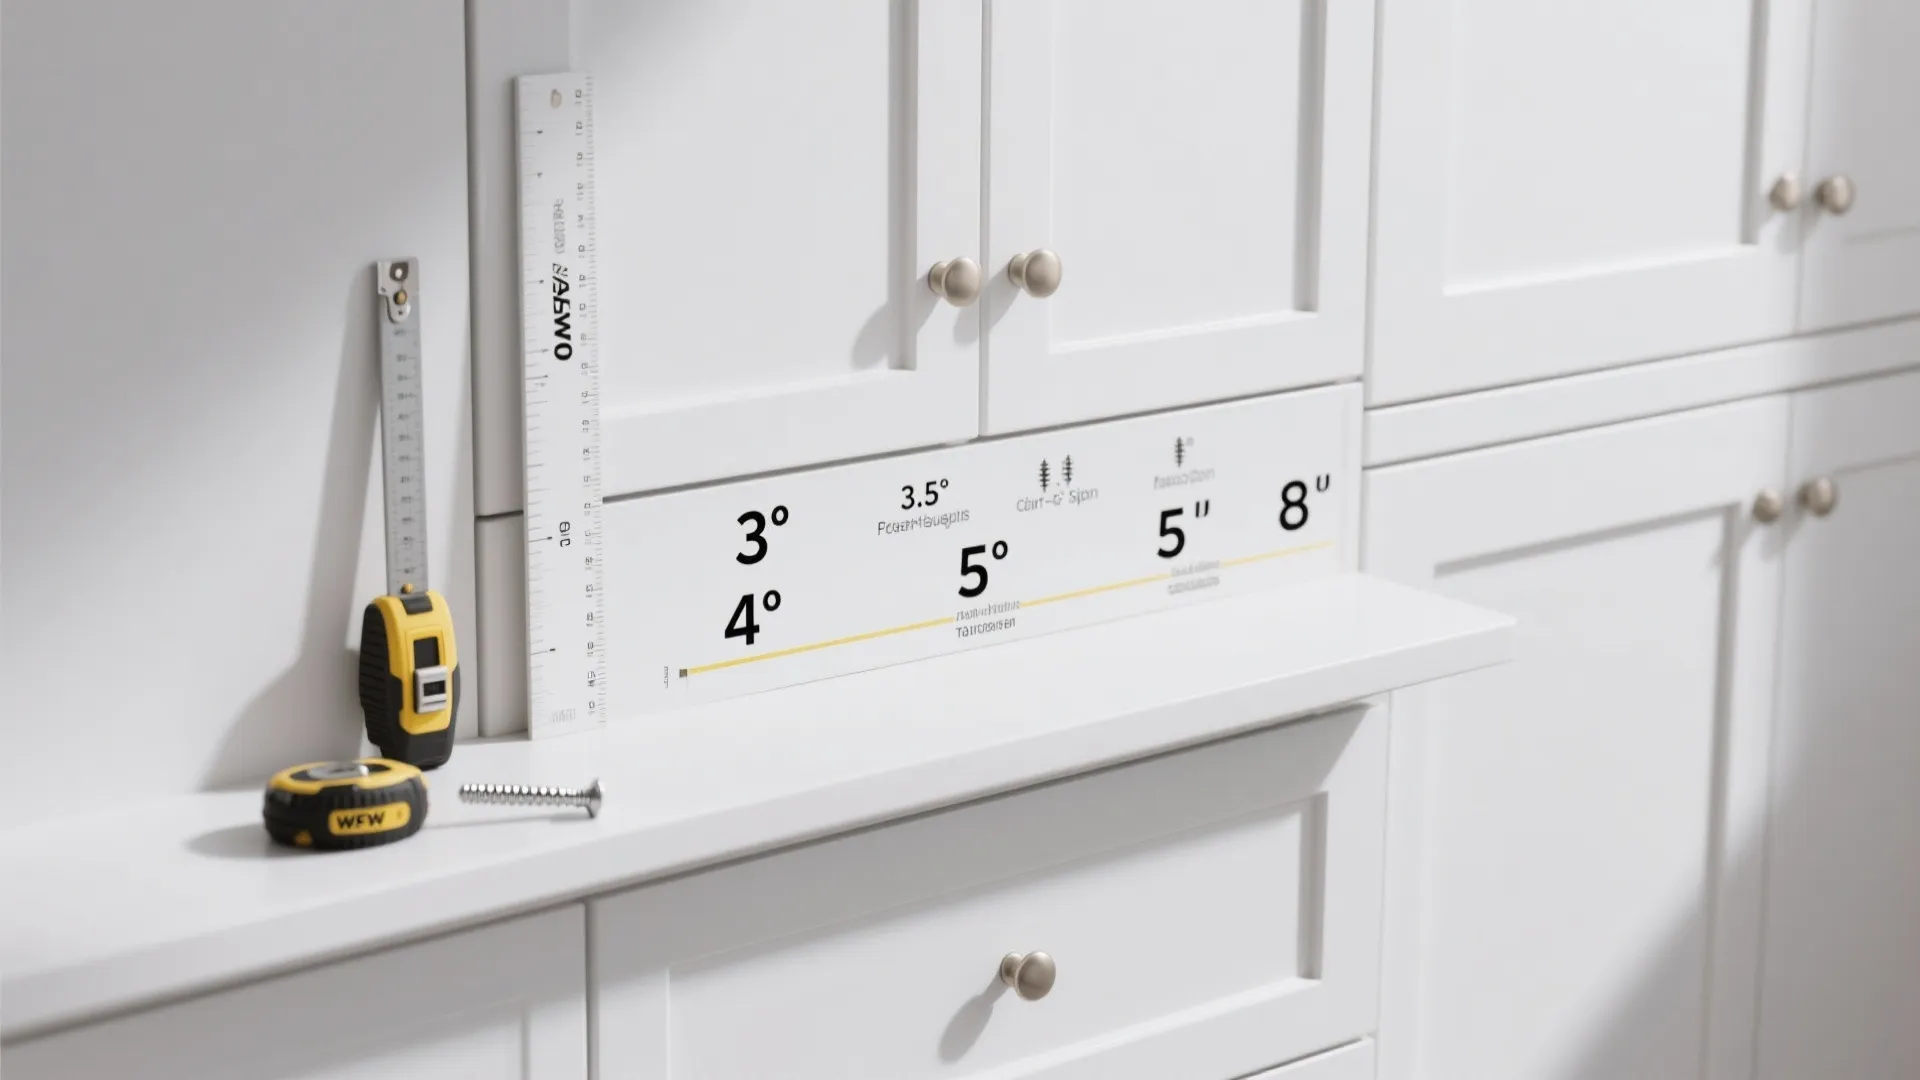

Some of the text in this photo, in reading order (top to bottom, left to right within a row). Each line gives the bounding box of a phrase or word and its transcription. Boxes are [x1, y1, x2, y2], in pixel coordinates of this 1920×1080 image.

[901, 478, 949, 511] 3.5°
[735, 504, 789, 566] 3°
[958, 540, 1009, 598] 5°
[724, 589, 782, 646] 4°
